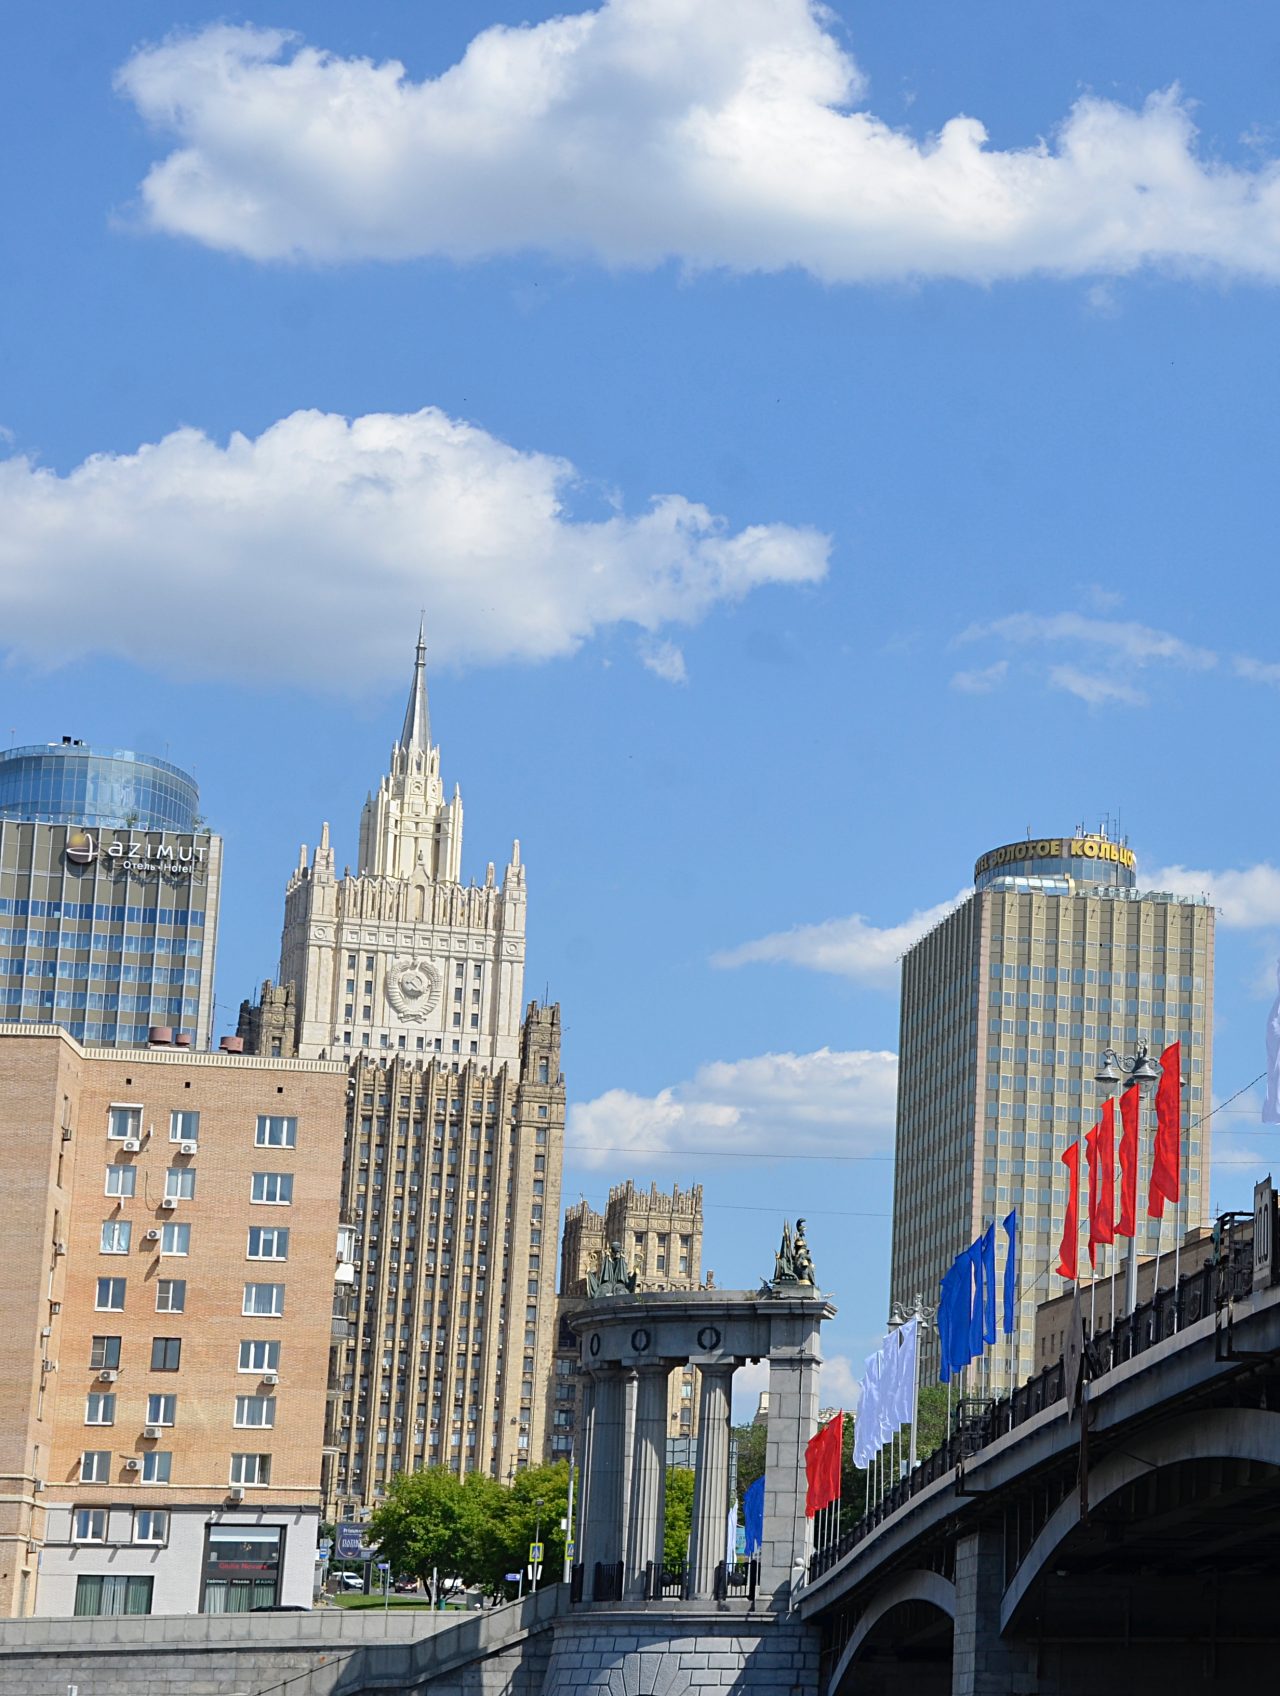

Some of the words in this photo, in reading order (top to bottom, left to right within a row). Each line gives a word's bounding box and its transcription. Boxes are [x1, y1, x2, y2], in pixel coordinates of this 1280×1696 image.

[991, 841, 1060, 866] ЗОЛОТОЕ
[1071, 841, 1133, 867] КОЛЬЦО
[123, 860, 156, 871] Отель
[163, 862, 193, 874] Hotel
